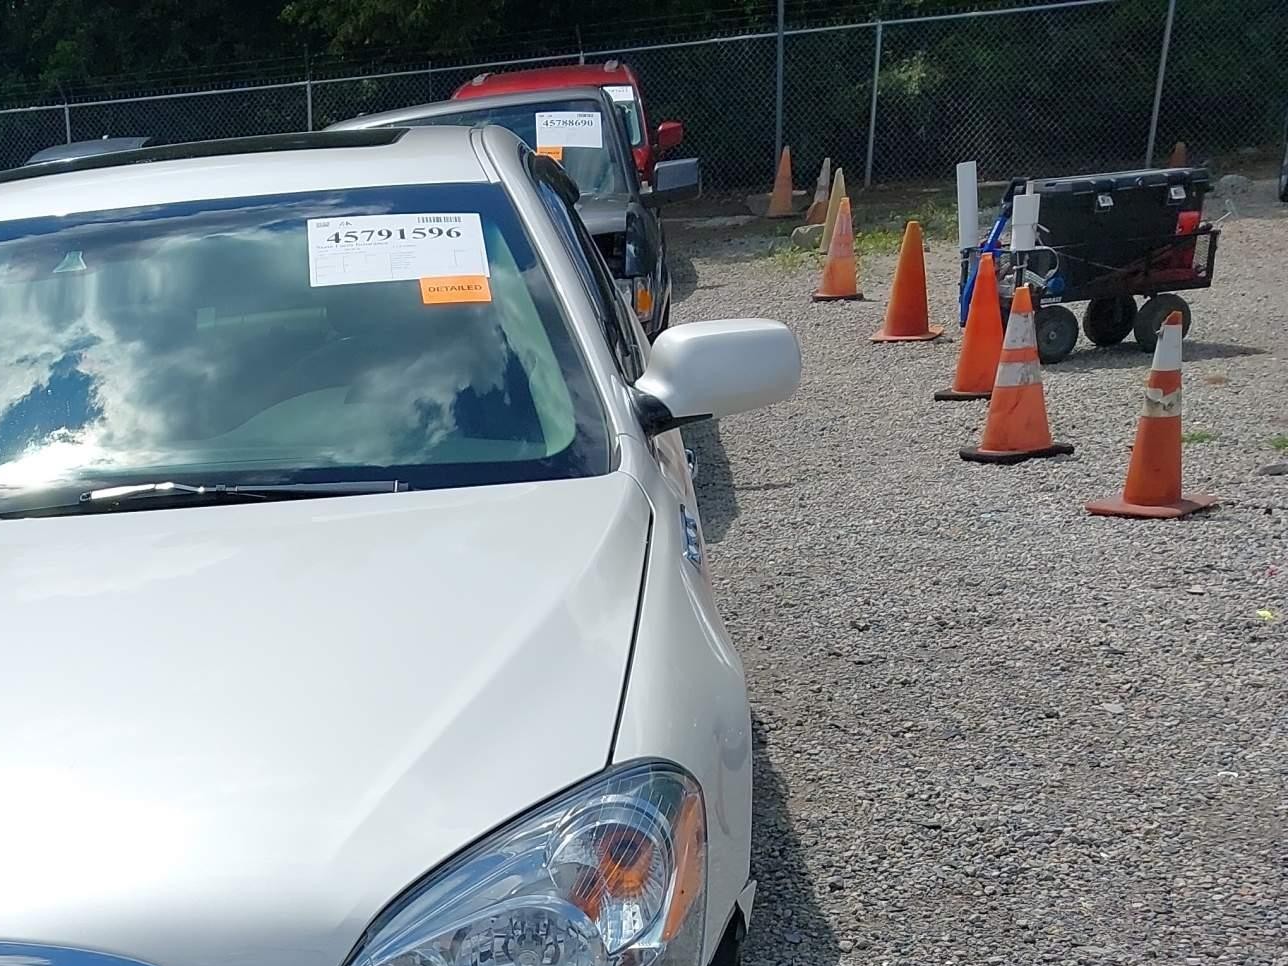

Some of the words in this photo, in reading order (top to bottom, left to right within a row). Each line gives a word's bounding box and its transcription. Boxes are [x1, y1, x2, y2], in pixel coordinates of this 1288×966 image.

[542, 119, 593, 127] 45788690
[326, 227, 462, 244] 45791596
[428, 284, 482, 293] DETAILED
